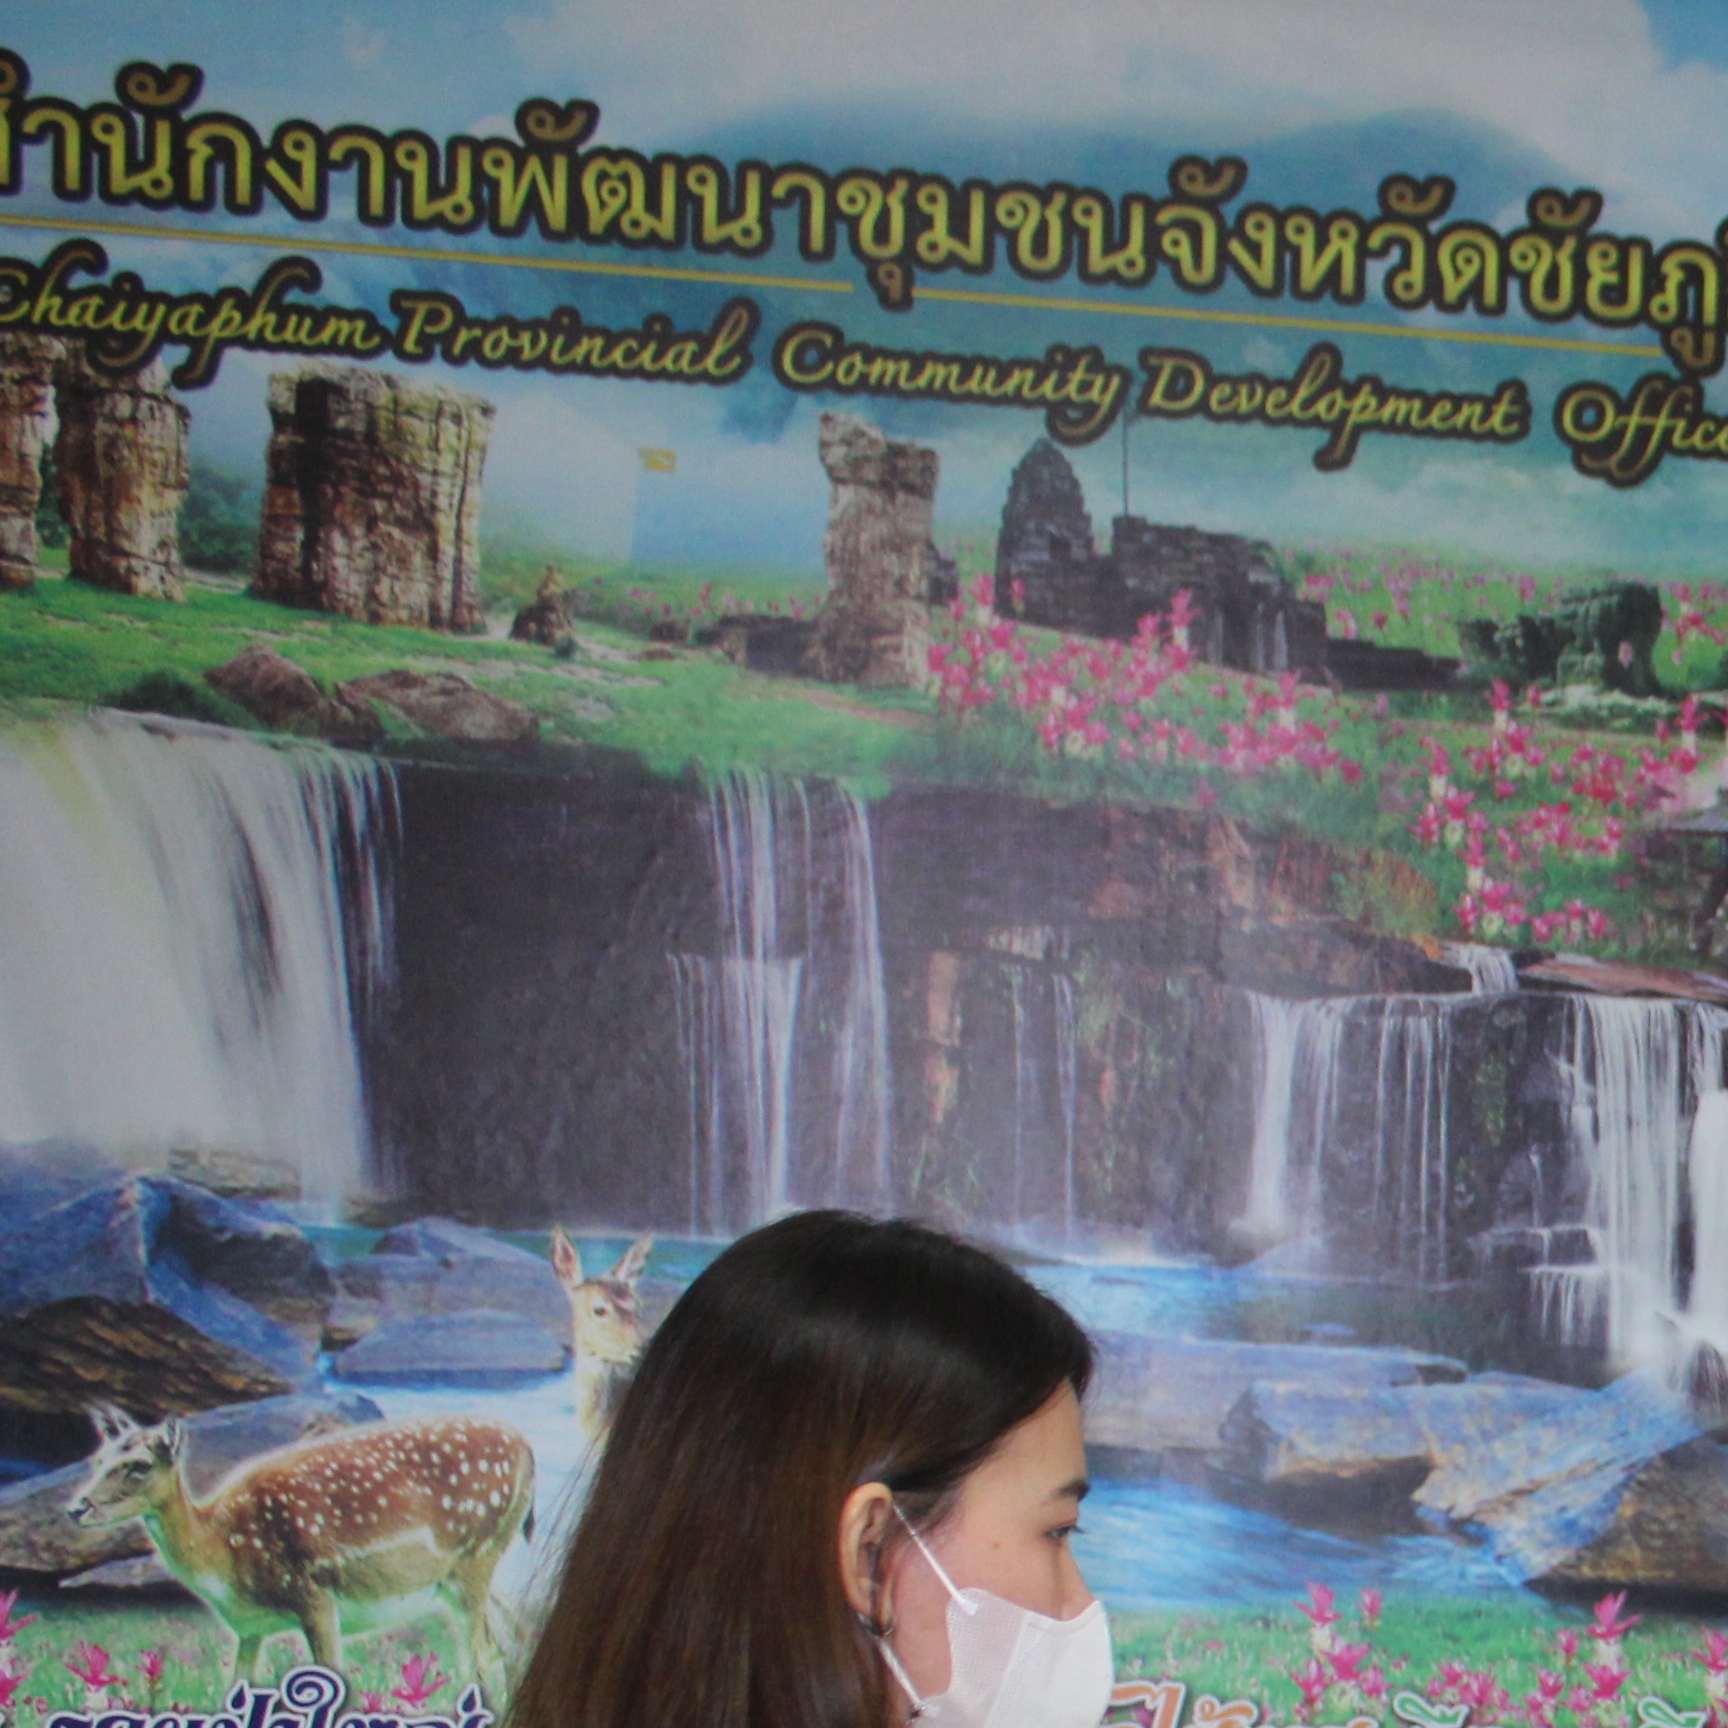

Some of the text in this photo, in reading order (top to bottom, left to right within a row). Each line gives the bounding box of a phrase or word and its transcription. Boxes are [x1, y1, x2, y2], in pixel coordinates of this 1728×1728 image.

[397, 296, 748, 382] Provincial
[779, 328, 1120, 440] Community
[1146, 344, 1524, 467] Development
